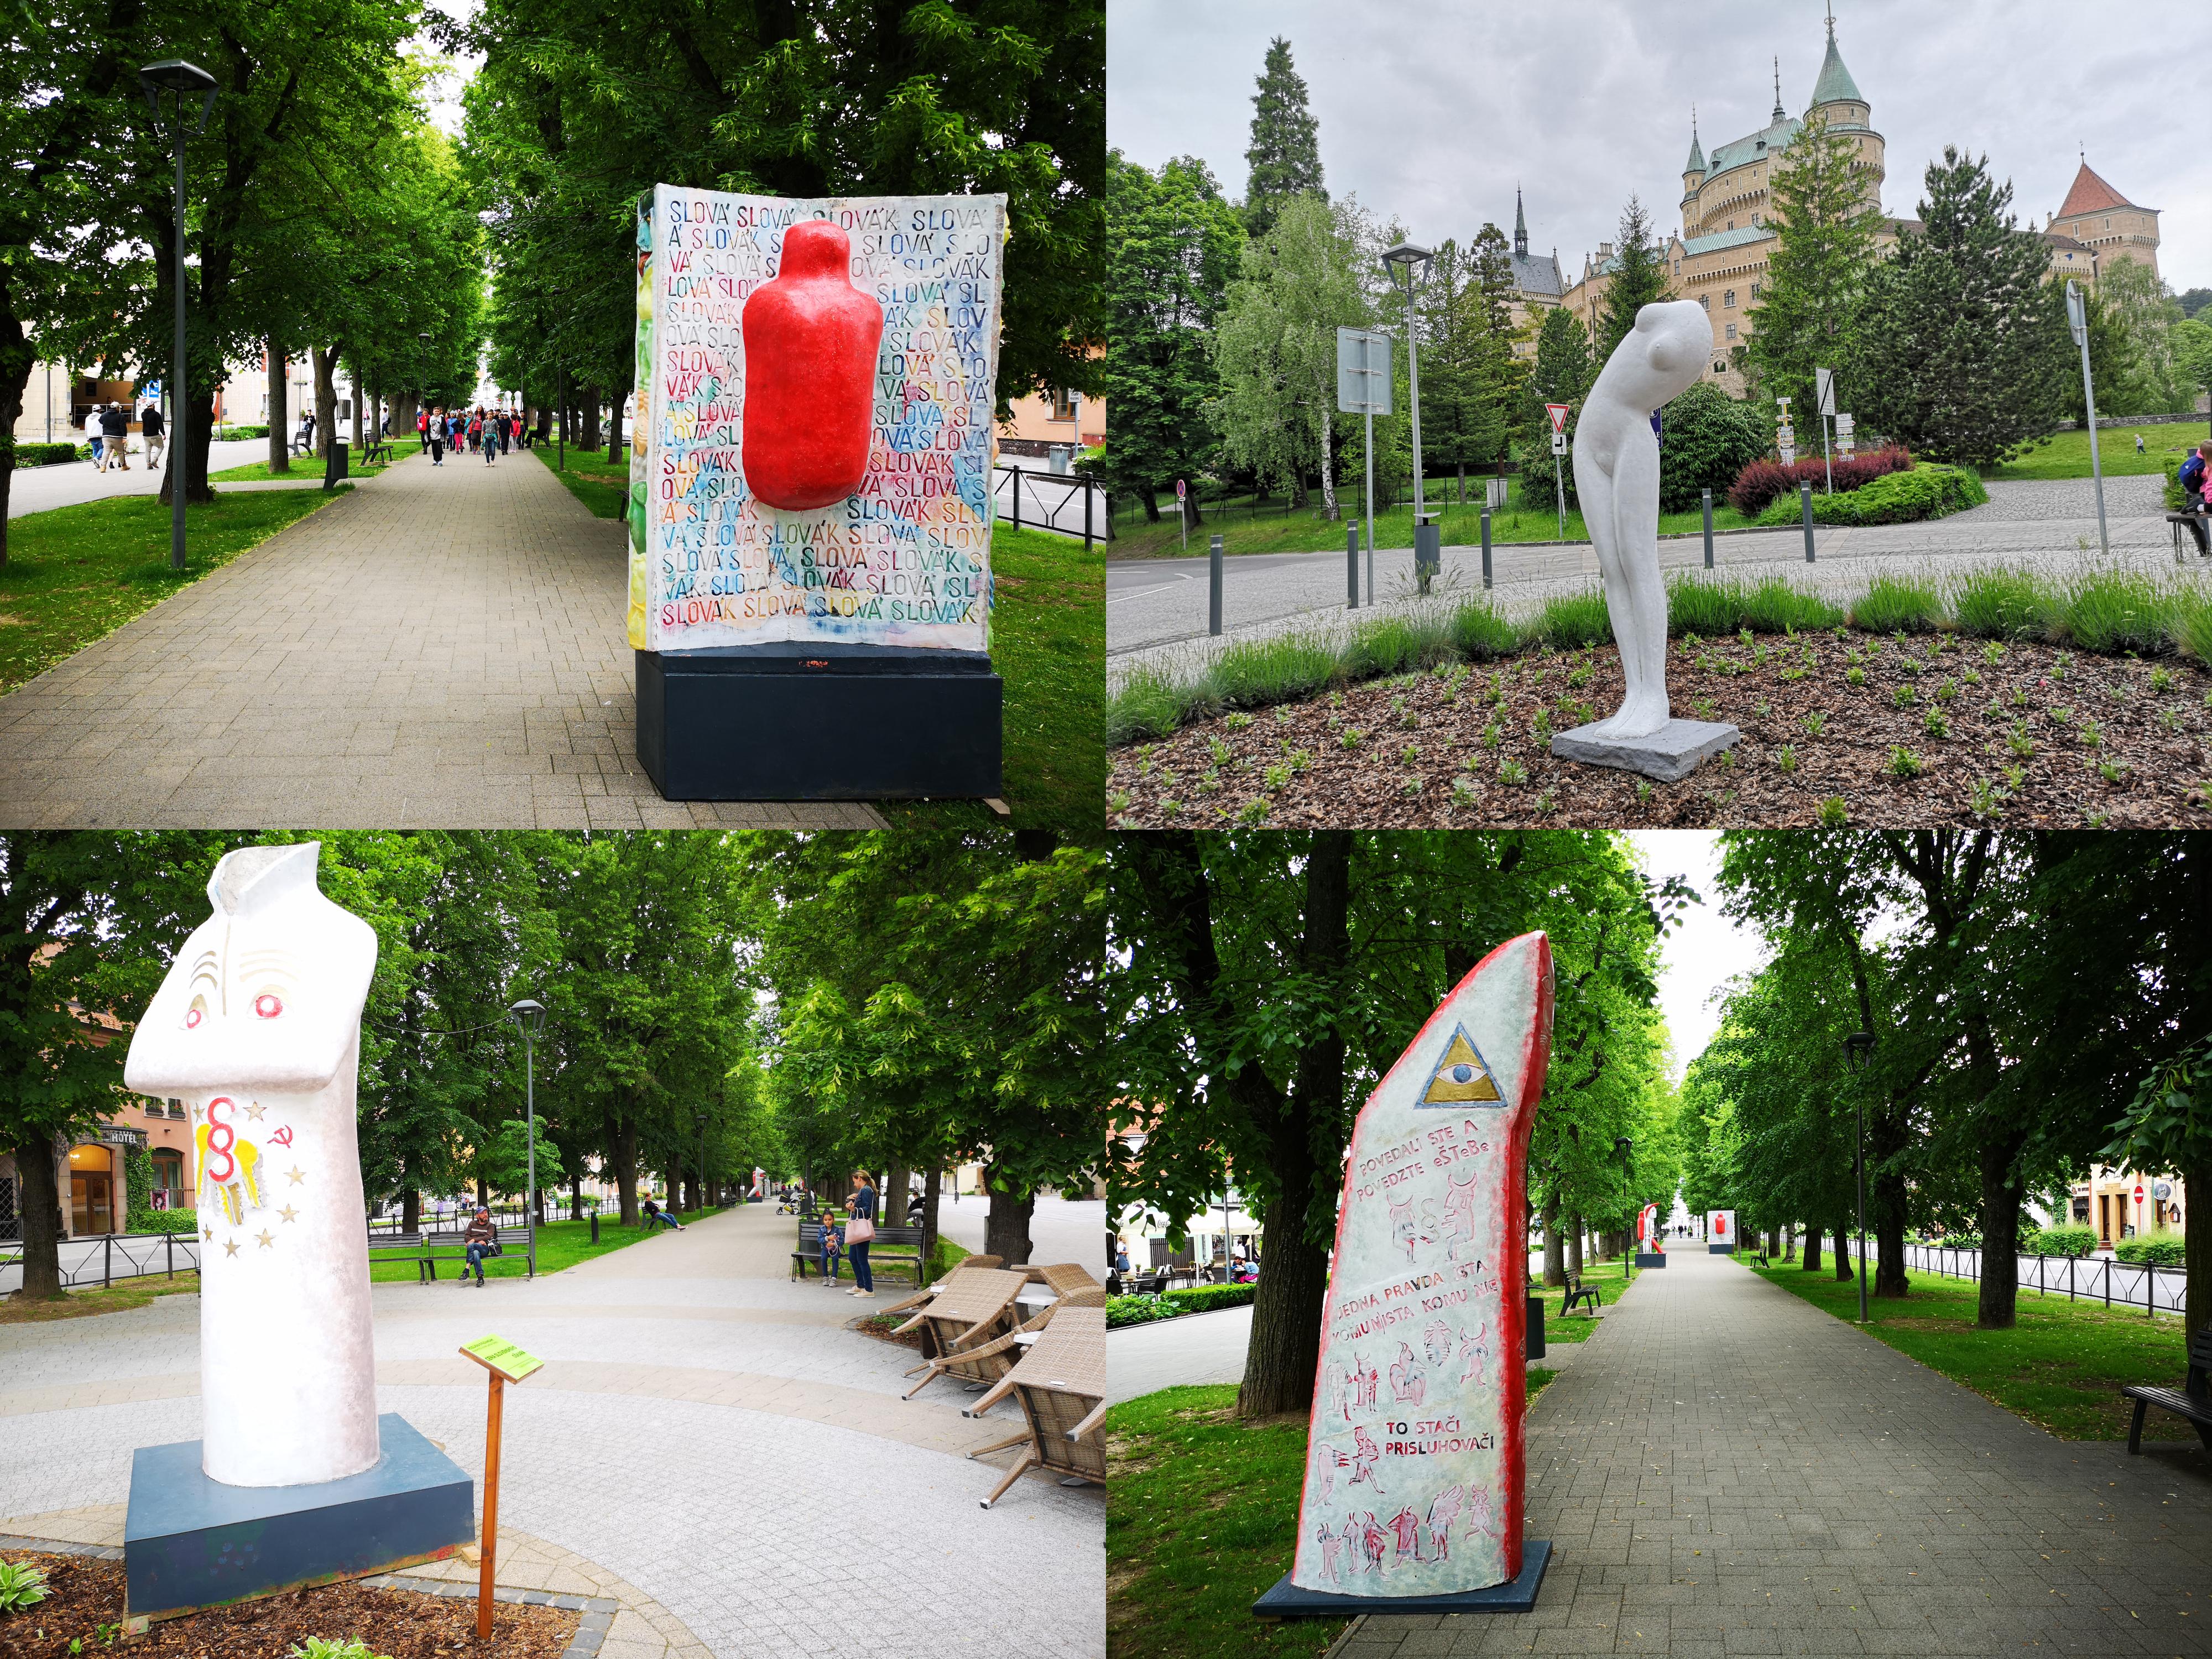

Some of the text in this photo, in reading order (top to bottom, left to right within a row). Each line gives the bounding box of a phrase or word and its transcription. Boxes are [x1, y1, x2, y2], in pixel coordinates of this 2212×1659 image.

[112, 1133, 137, 1144] HOTEL
[1359, 1138, 1423, 1177] POVEDALI
[1427, 1126, 1455, 1145] STE
[1357, 1162, 1425, 1203] POVEDZTE
[1338, 1293, 1380, 1320] JEDNA
[1384, 1271, 1444, 1301] PRAVDA
[1421, 1289, 1468, 1313] KOMU
[1474, 1279, 1498, 1297] NIE
[1386, 1416, 1460, 1435] TO STAČI
[1386, 1432, 1494, 1455] PRISLUHOVAČI
